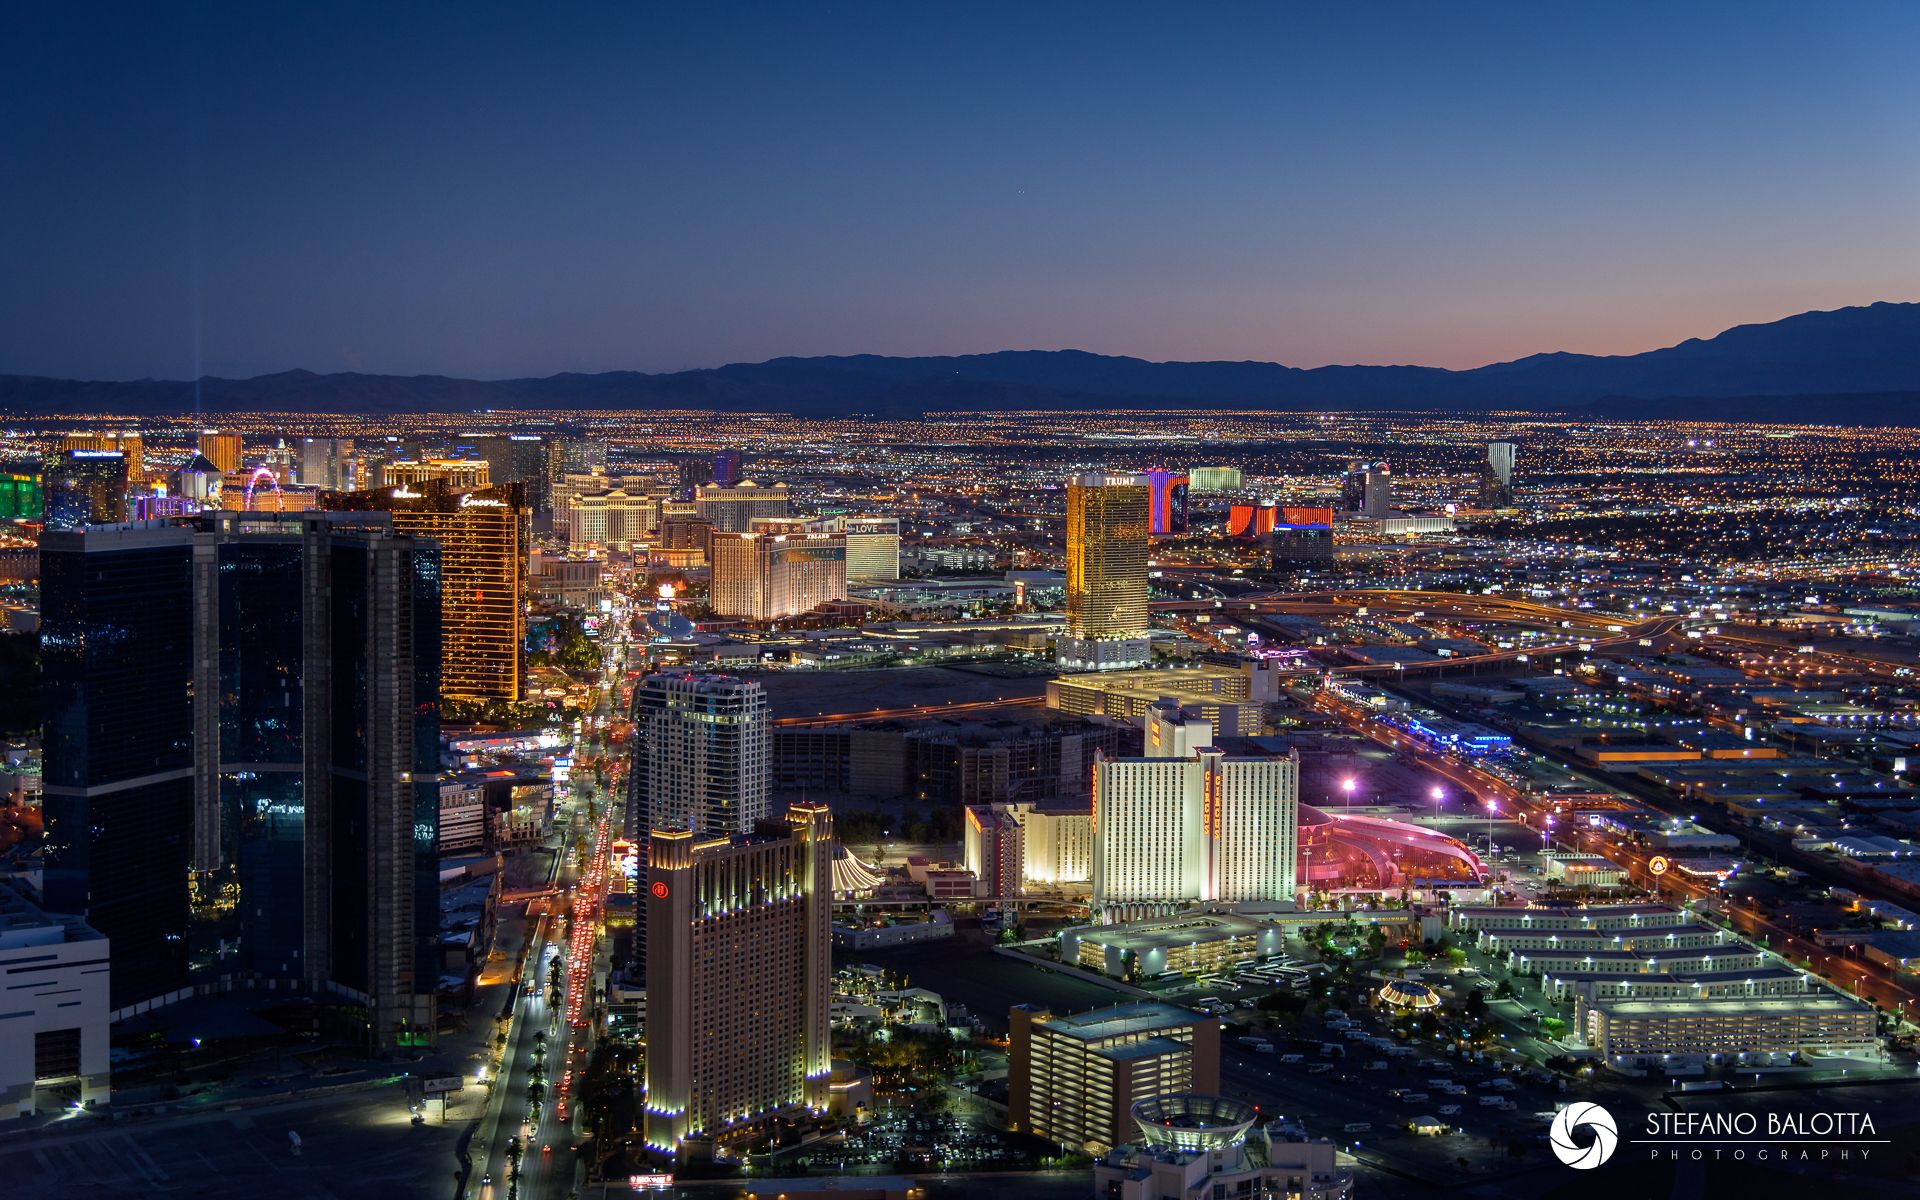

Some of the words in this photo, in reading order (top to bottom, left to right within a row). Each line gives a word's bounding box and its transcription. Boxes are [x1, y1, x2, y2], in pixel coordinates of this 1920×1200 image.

[1105, 477, 1135, 486] TRUMP
[459, 492, 507, 507] Encore
[855, 525, 878, 533] LOVE
